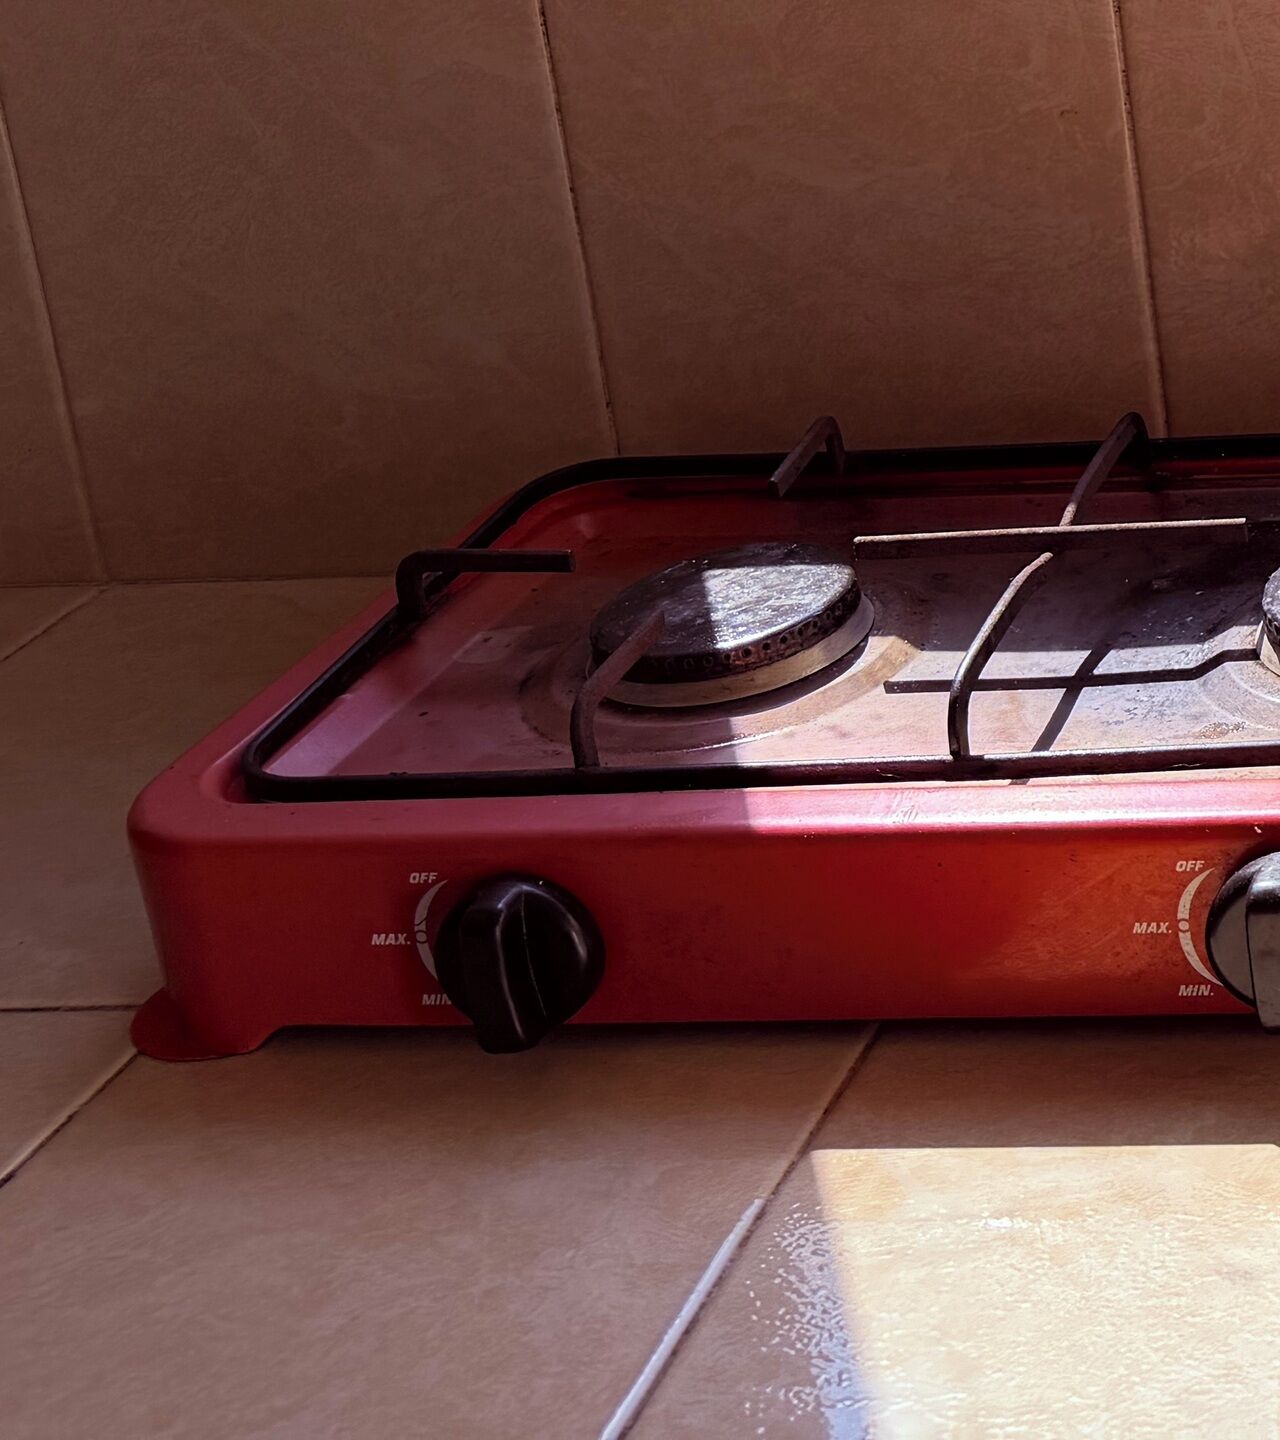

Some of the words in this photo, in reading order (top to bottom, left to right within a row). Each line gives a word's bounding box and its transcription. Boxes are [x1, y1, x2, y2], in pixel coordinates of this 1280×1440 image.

[1175, 860, 1205, 872] OFF
[409, 872, 438, 884] OFF
[1132, 922, 1172, 934] MAX.
[371, 933, 411, 946] MAX.
[1178, 984, 1214, 997] MIN.
